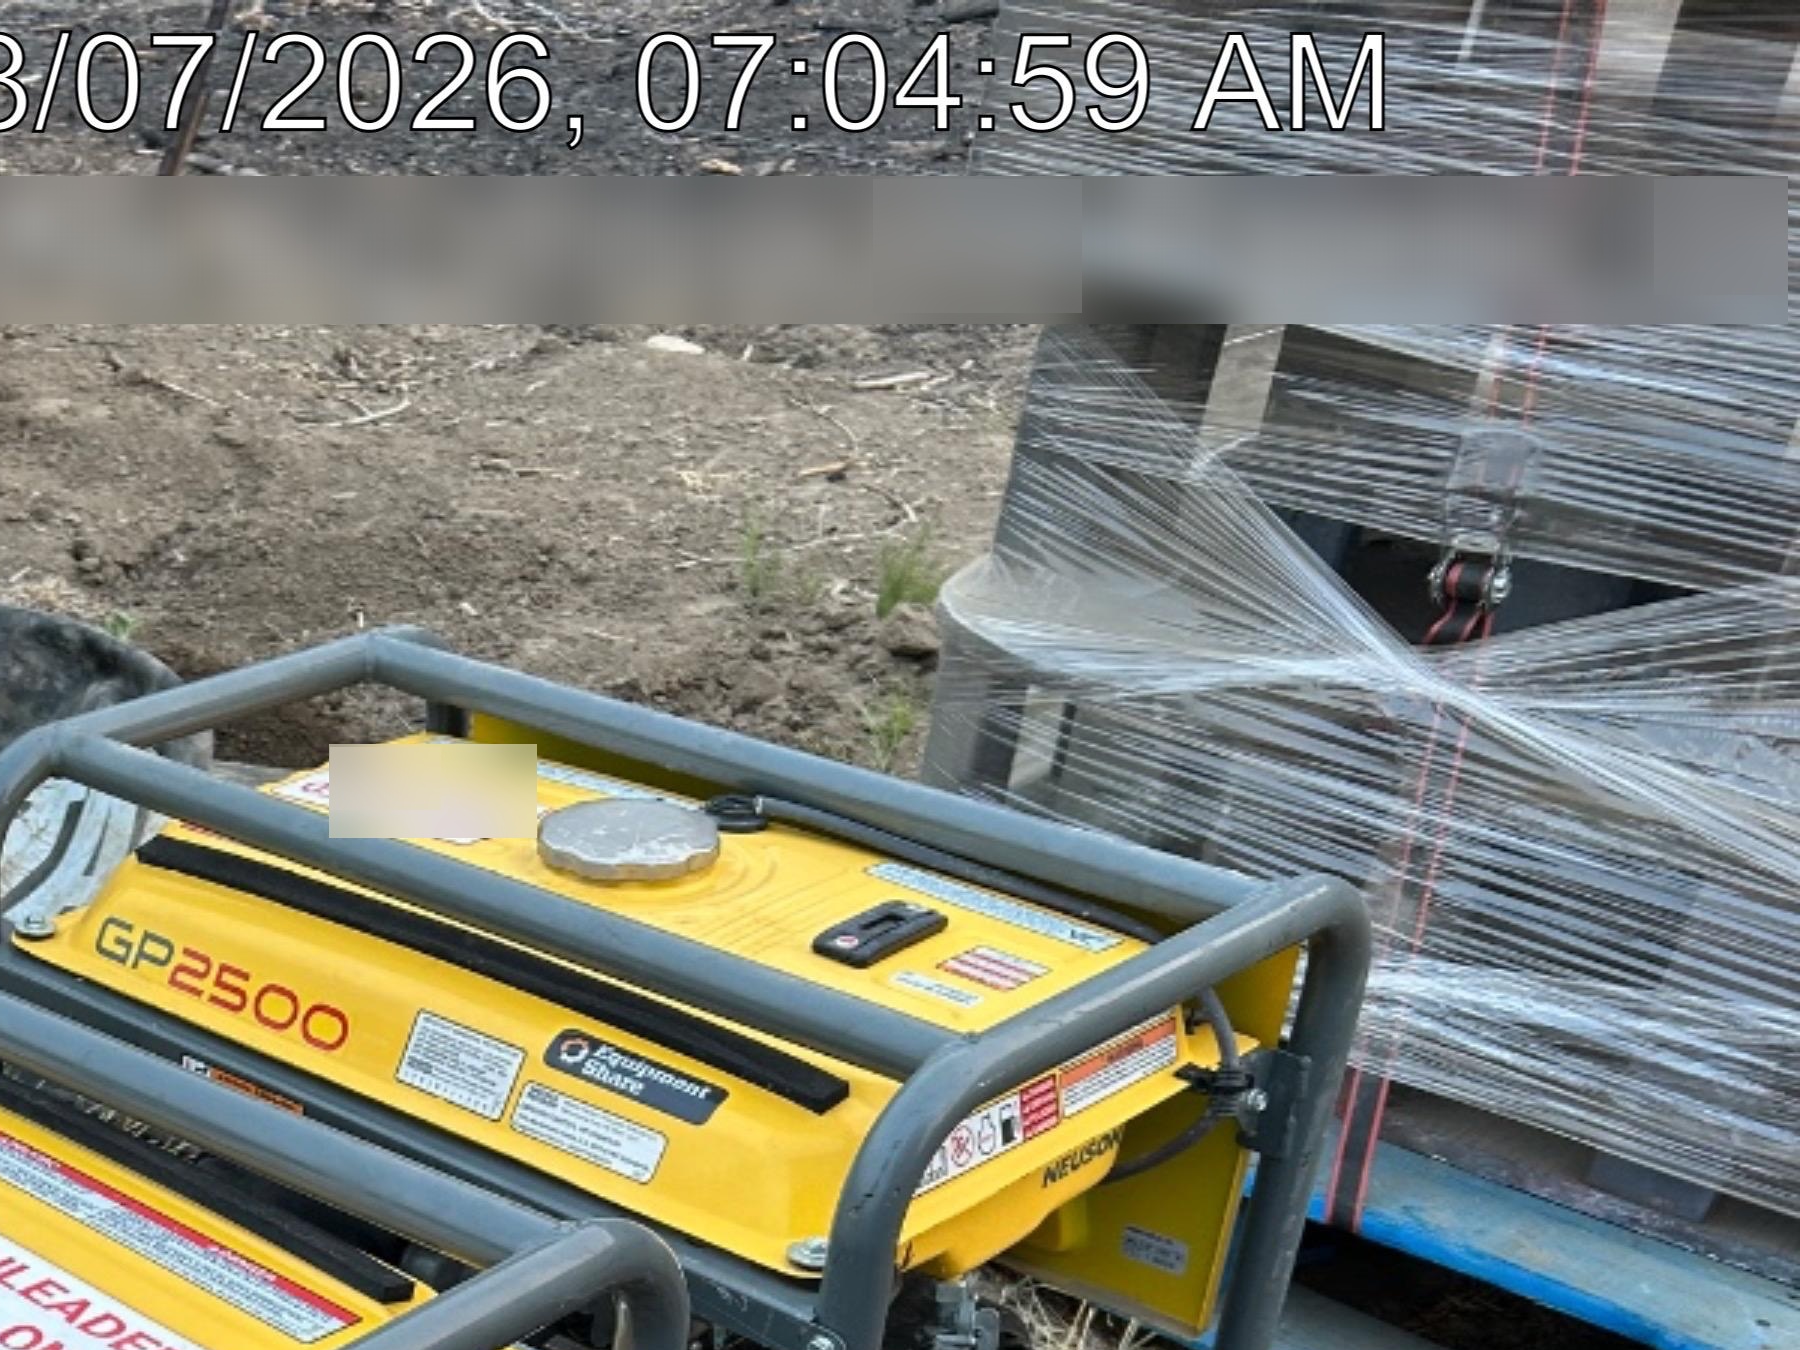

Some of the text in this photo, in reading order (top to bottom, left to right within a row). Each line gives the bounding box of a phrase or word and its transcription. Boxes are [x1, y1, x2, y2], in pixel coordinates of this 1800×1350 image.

[95, 916, 349, 1051] GP2500
[581, 1058, 645, 1096] Share
[592, 1044, 712, 1099] Equipment
